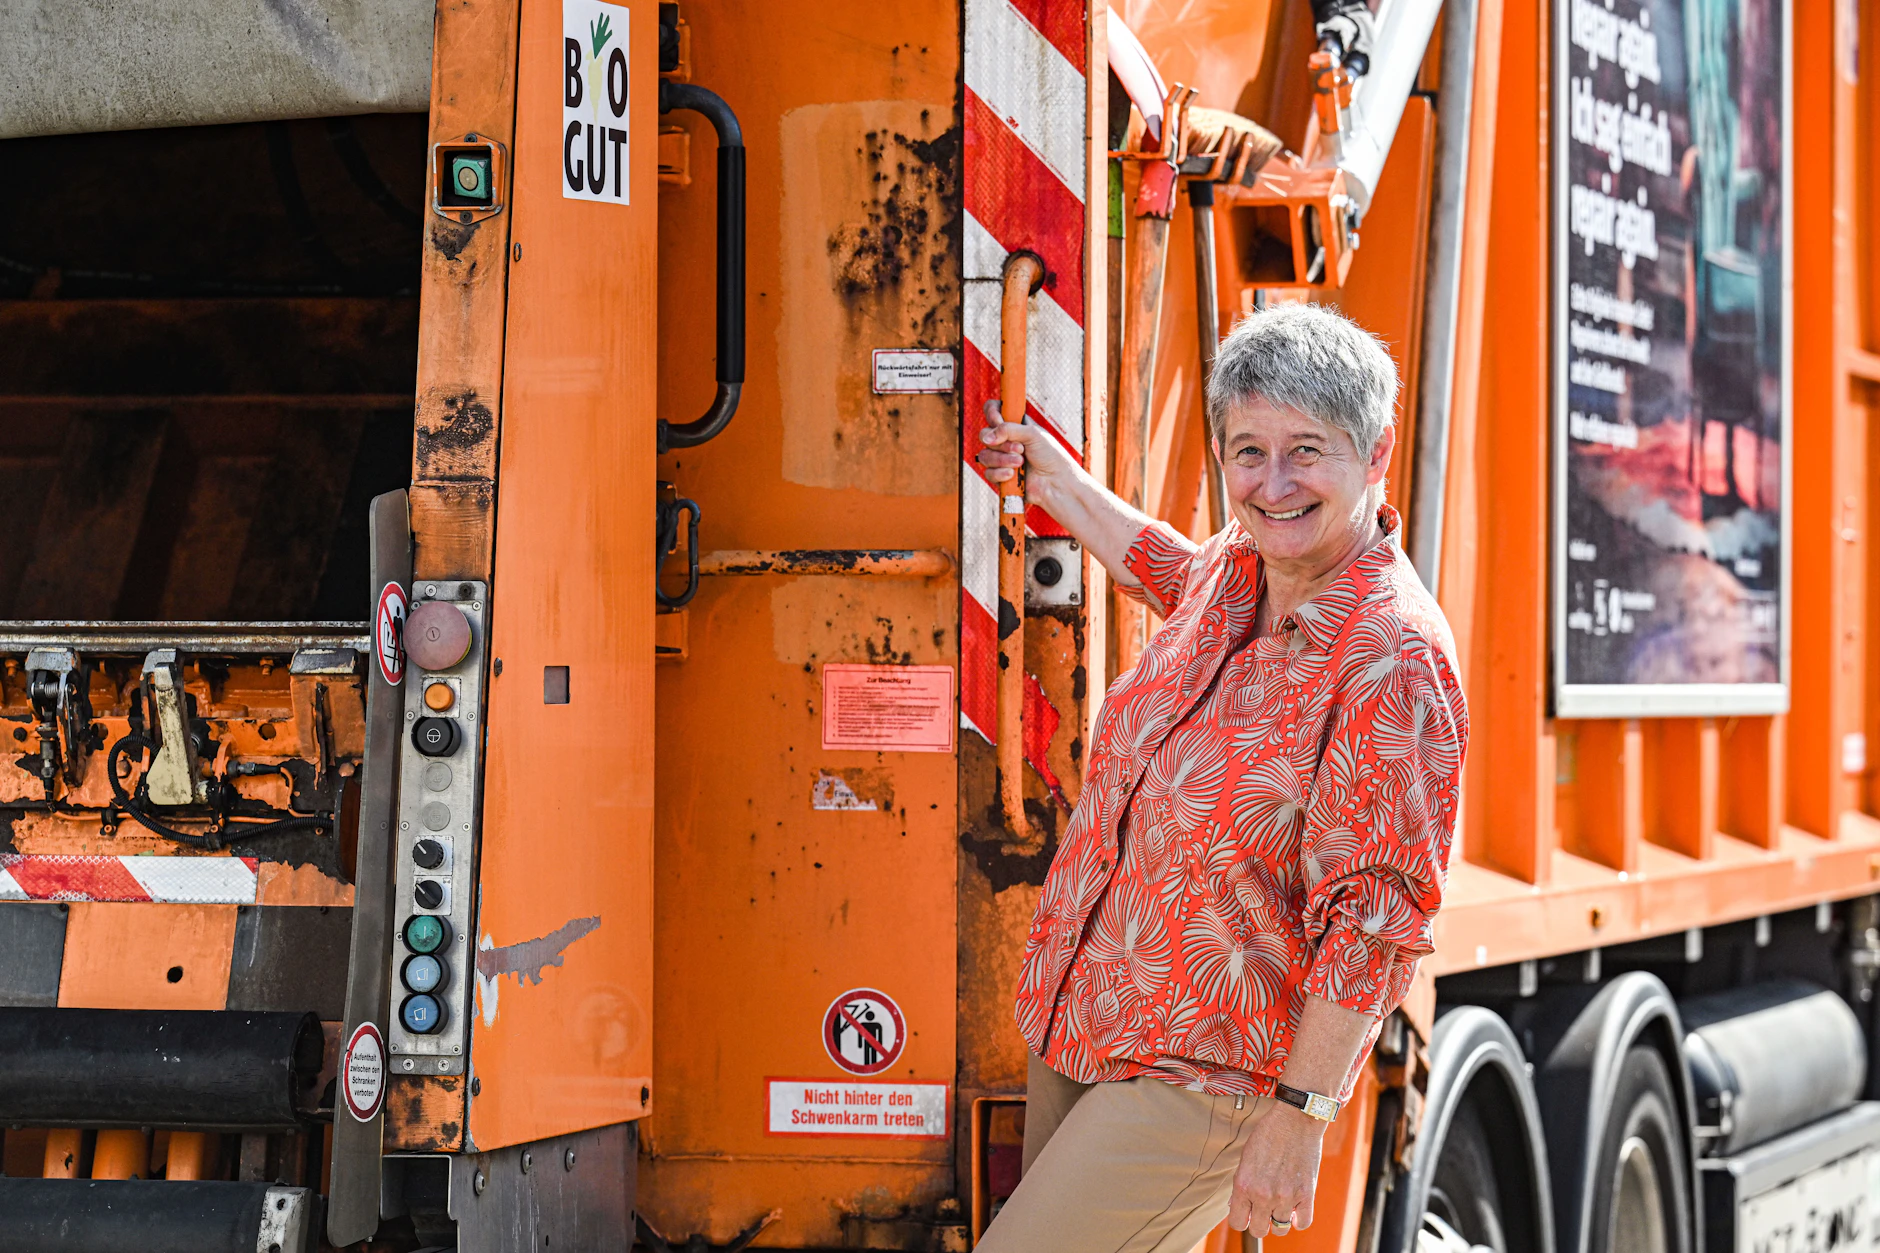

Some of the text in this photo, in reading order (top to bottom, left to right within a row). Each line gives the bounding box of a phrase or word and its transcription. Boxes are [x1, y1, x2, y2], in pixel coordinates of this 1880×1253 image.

[564, 120, 627, 197] GUT
[353, 1053, 377, 1062] Aufenthalt
[350, 1065, 371, 1073] zwischen
[352, 1076, 376, 1085] Schranken
[354, 1089, 374, 1097] verboten
[804, 1089, 913, 1106] Nicht hinter den
[791, 1109, 924, 1127] Schwenkarm treten
